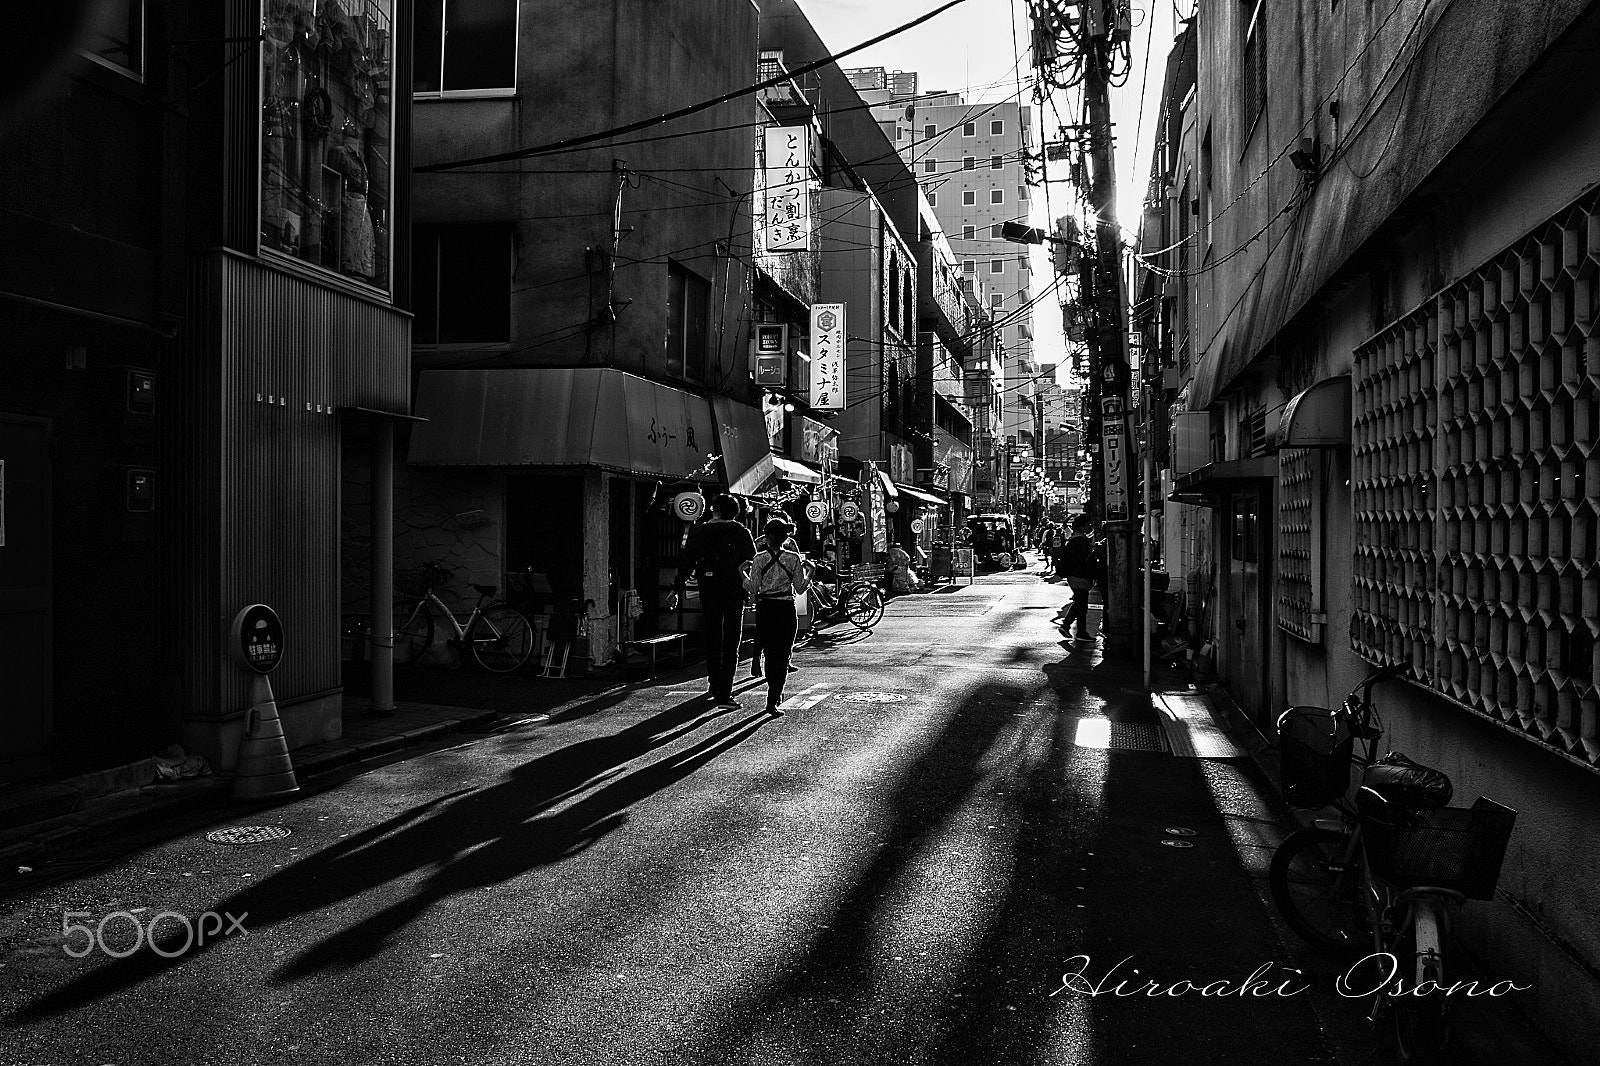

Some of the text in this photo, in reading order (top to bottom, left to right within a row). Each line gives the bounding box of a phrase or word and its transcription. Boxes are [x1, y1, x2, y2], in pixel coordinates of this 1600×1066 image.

[815, 334, 831, 406] スタミナ屋
[1107, 438, 1121, 485] ローソン
[248, 642, 278, 656] 駐車禁止
